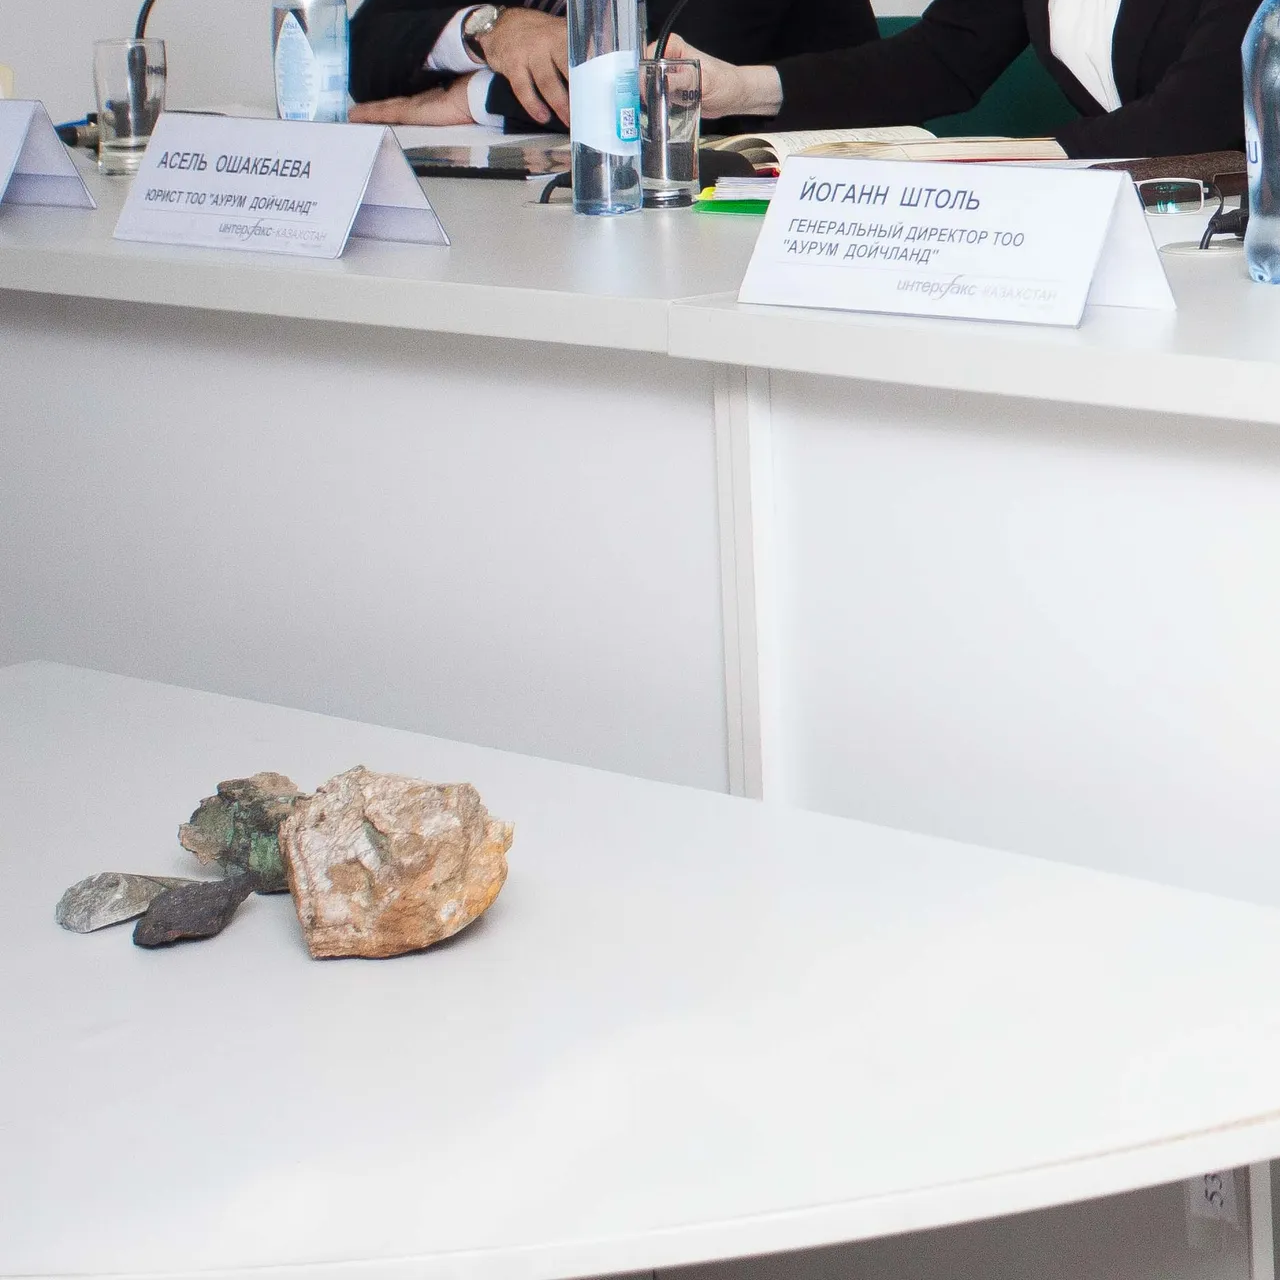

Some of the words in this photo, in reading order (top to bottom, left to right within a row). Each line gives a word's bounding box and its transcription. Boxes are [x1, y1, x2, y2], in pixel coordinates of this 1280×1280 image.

[157, 151, 208, 172] АСЕЛЬ
[215, 155, 311, 179] ОШАКБАЕВА
[145, 188, 182, 202] ЮРИСТ
[186, 192, 207, 205] ТОО
[209, 194, 246, 208] "АУРУМ
[799, 176, 890, 206] ЙОГАНН
[900, 186, 981, 211] ШТОЛЬ
[788, 218, 903, 239] ГЕНЕРАЛЬНЫЙ
[904, 225, 989, 243] ДИРЕКТОР
[993, 231, 1025, 247] ТОО
[783, 239, 839, 257] "АУРУМ
[843, 242, 940, 265] ДОЙЧЛАНД"
